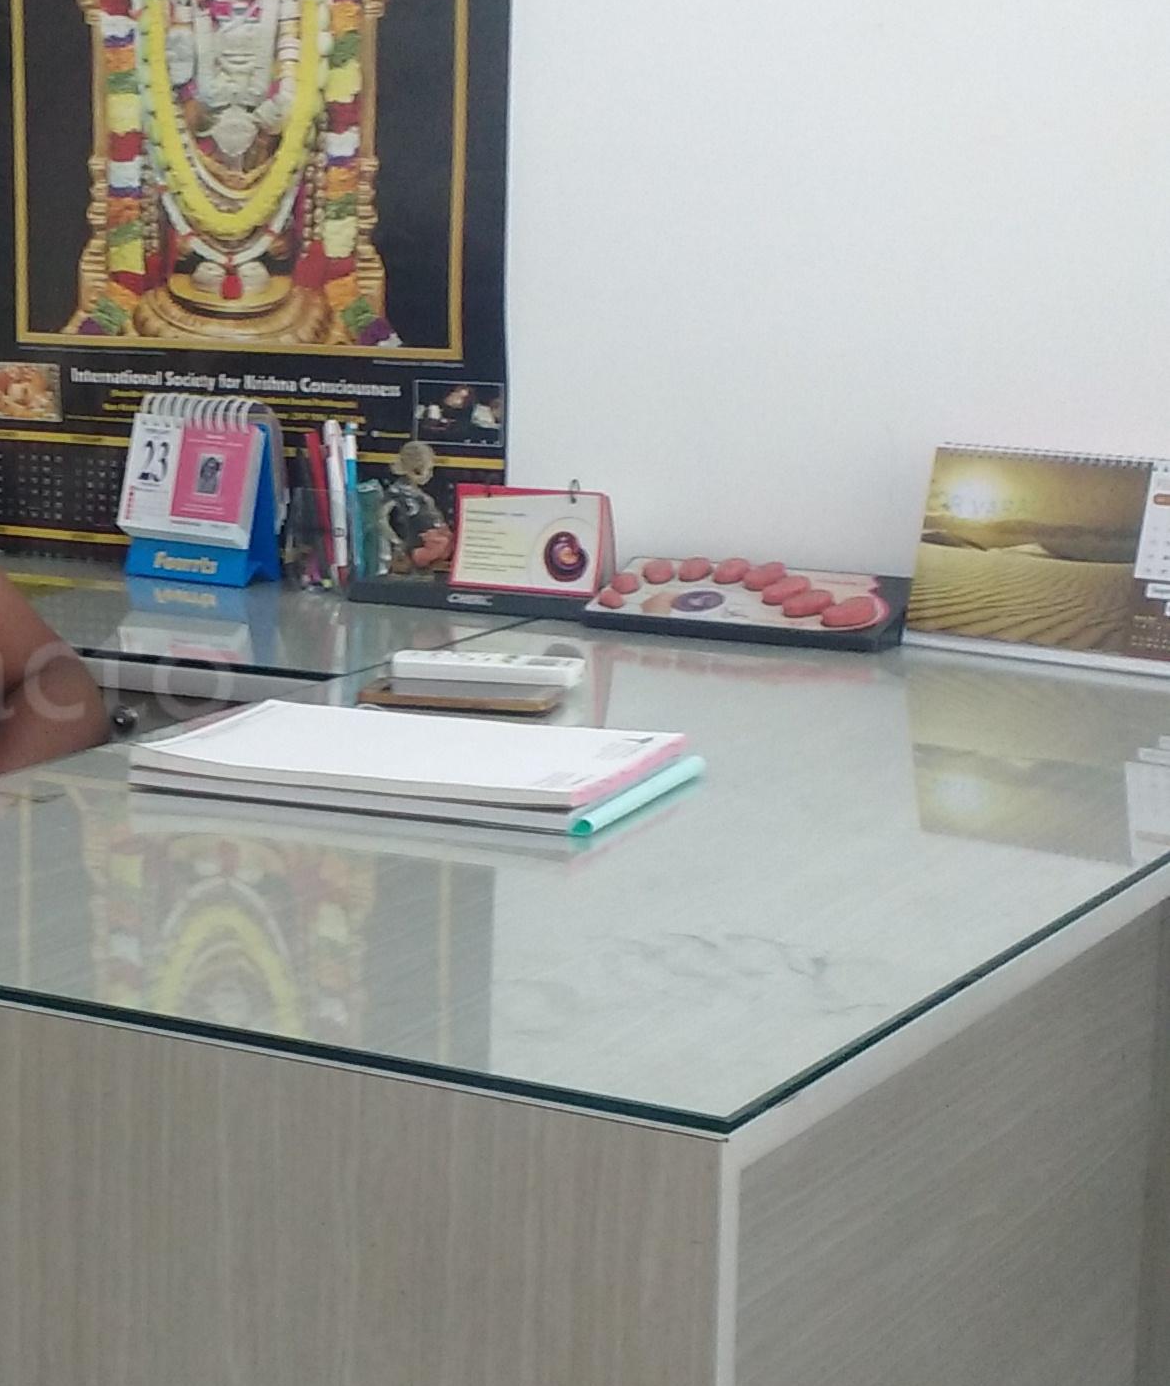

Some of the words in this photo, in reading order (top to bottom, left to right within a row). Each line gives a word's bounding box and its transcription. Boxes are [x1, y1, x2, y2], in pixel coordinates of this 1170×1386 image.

[70, 367, 163, 385] International
[165, 371, 216, 391] Society
[218, 373, 240, 389] for
[243, 375, 297, 392] Krishna
[299, 377, 402, 397] Consciousness
[137, 439, 171, 482] 23
